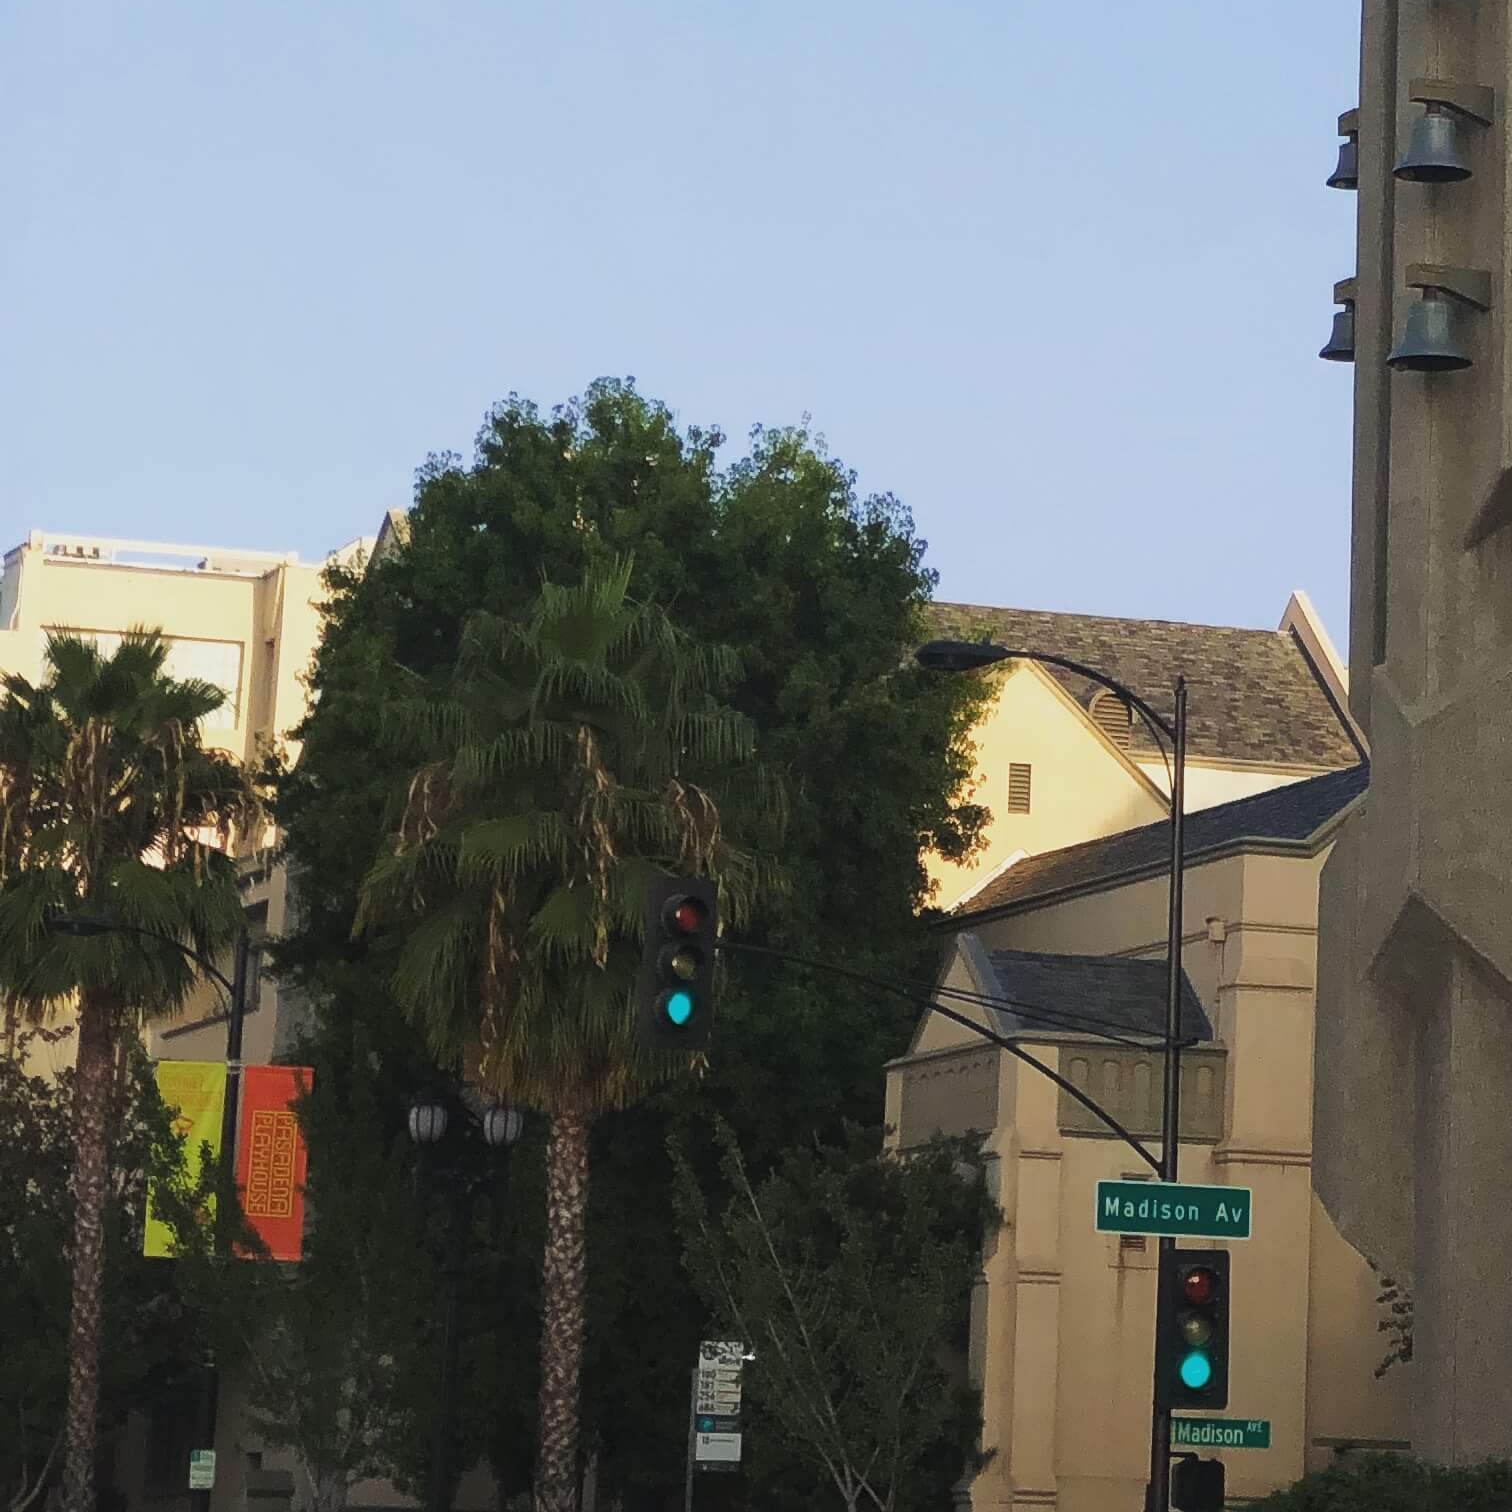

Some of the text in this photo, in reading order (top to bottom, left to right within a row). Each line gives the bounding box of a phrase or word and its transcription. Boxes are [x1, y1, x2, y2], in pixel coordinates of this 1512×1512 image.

[249, 1114, 273, 1213] PLAYHOUSE
[271, 1114, 294, 1213] PASADENA
[1105, 1196, 1242, 1222] Madison Av
[1178, 1420, 1262, 1444] Madison AVE
